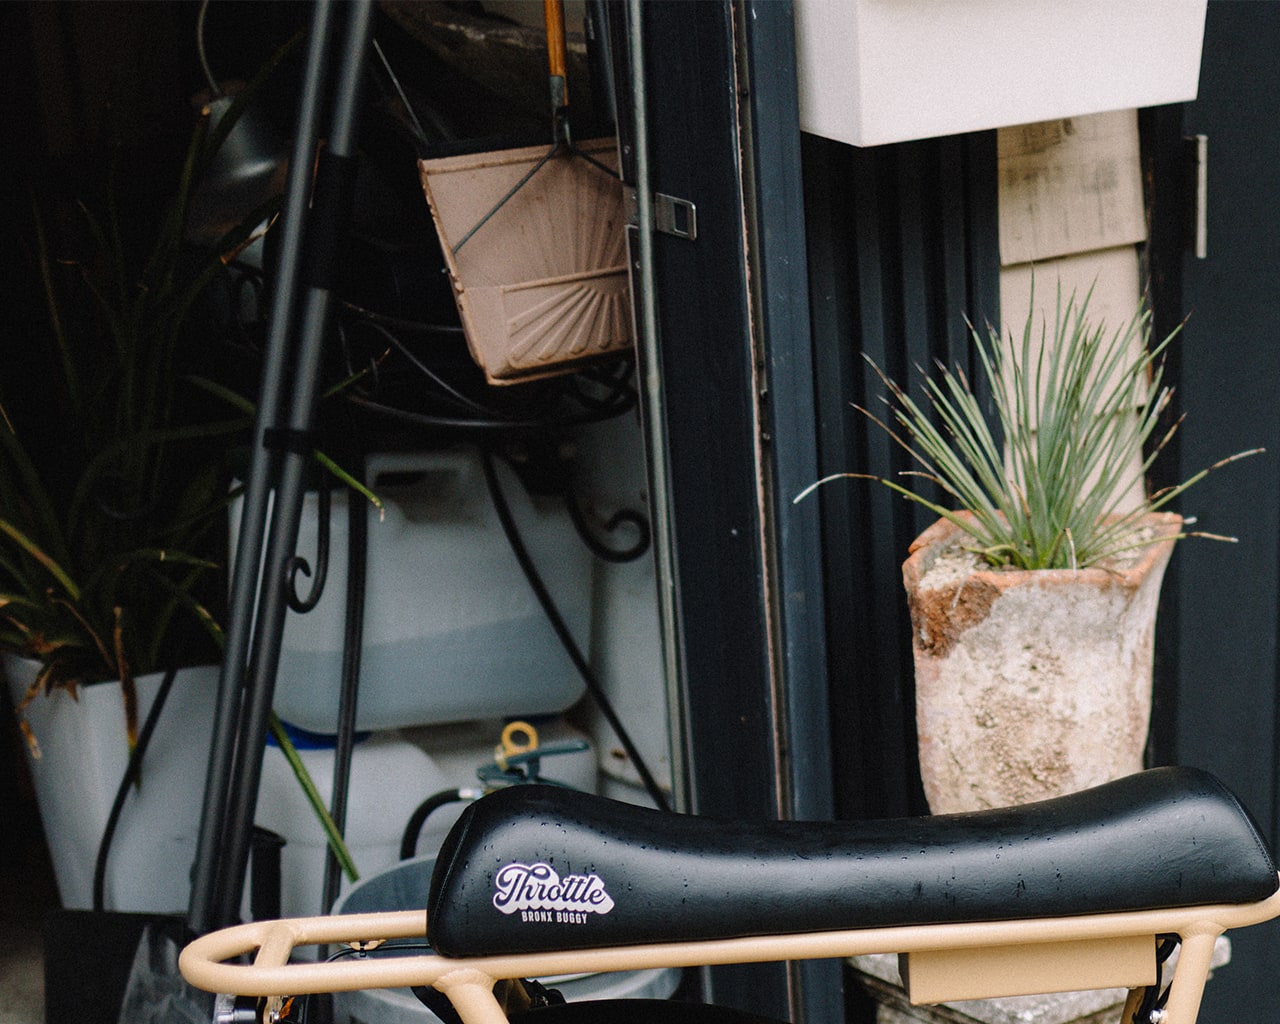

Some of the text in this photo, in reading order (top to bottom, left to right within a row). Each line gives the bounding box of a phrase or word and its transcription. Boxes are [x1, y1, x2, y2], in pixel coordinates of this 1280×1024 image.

[493, 863, 615, 915] Throttle
[521, 911, 588, 925] BRONX BUGGY
